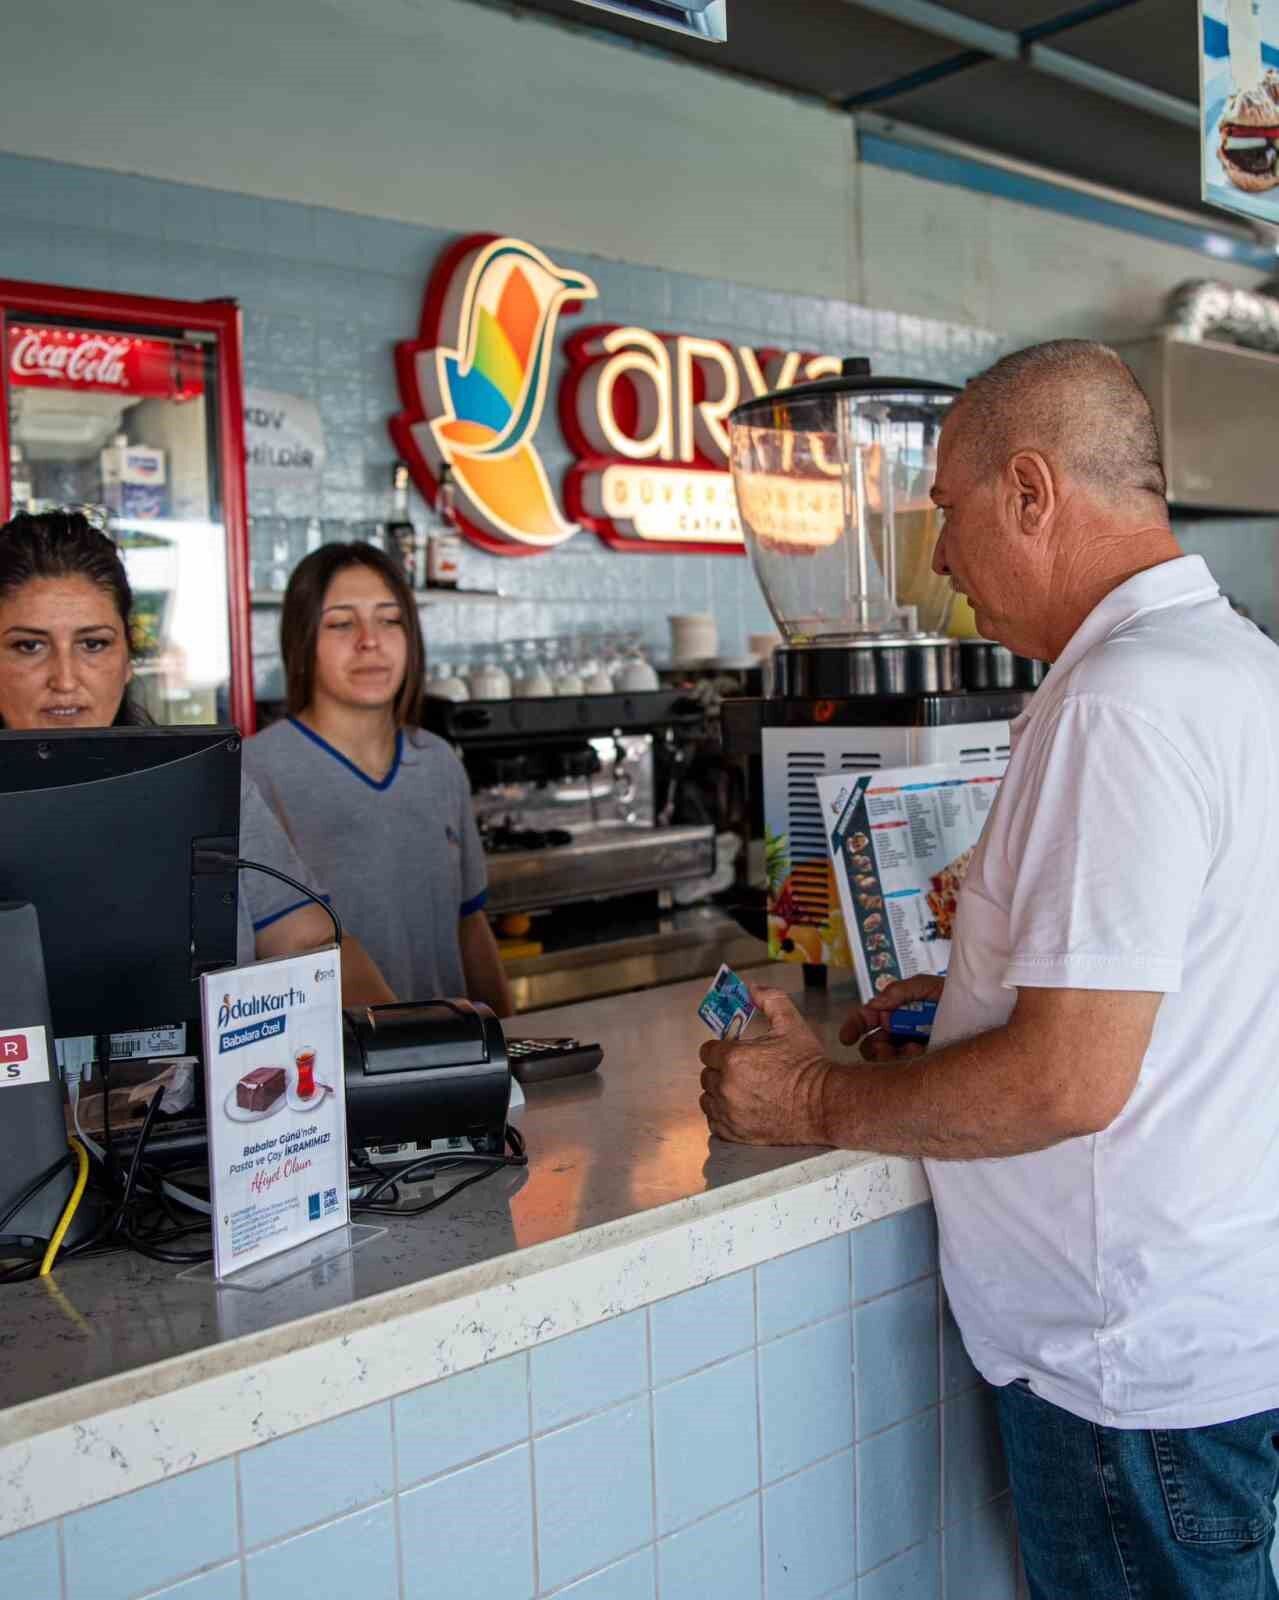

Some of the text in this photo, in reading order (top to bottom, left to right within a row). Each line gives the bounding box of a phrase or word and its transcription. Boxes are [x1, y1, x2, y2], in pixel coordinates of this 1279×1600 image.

[222, 1020, 281, 1049] Babalara Özel
[243, 1125, 318, 1157] Babalar Günü'nde
[229, 1160, 254, 1175] Pasta
[255, 1157, 265, 1166] ve
[267, 1151, 282, 1165] Çay
[251, 1156, 312, 1193] Afiyet Olsun
